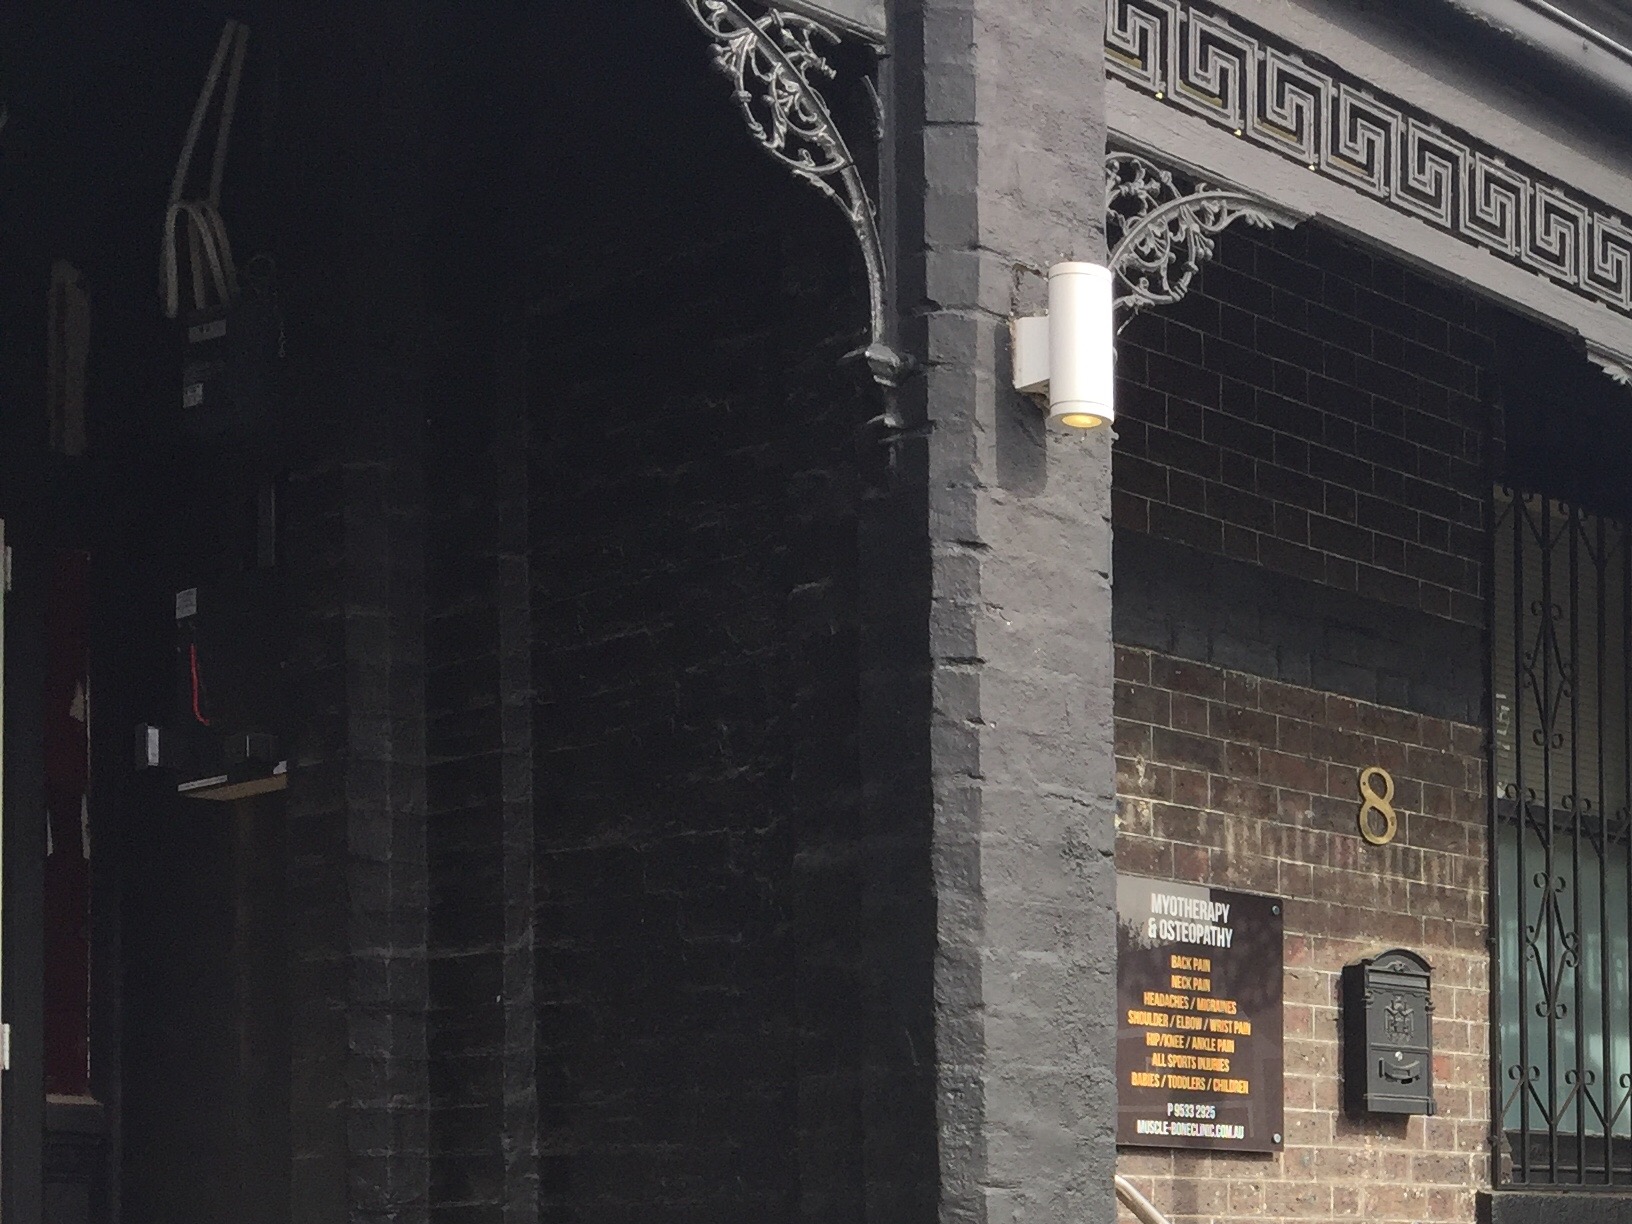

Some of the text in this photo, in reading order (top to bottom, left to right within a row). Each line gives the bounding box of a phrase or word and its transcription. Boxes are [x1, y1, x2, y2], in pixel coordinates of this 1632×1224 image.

[1359, 766, 1397, 845] 8
[1151, 893, 1230, 923] MYOTHERAPY
[1148, 917, 1233, 948] & OSTEOPATHY
[1171, 955, 1211, 973] BACK PAIN
[1171, 975, 1211, 993] NECK PAIN
[1144, 991, 1189, 1010] HEADACHES
[1197, 998, 1237, 1015] MIGRAINES
[1128, 1009, 1169, 1027] SHOULDER
[1176, 1016, 1203, 1031] ELBOW
[1209, 1019, 1232, 1034] WRIST
[1234, 1021, 1251, 1036] PAIN
[1192, 1037, 1215, 1051] ANKLE
[1217, 1039, 1235, 1053] PAIN
[1152, 1053, 1166, 1068] ALL
[1168, 1055, 1197, 1070] SPORTS
[1131, 1072, 1160, 1088] BABIES
[1167, 1075, 1206, 1091] TODDLERS
[1213, 1079, 1249, 1094] CHILDREN
[1167, 1103, 1173, 1117] P
